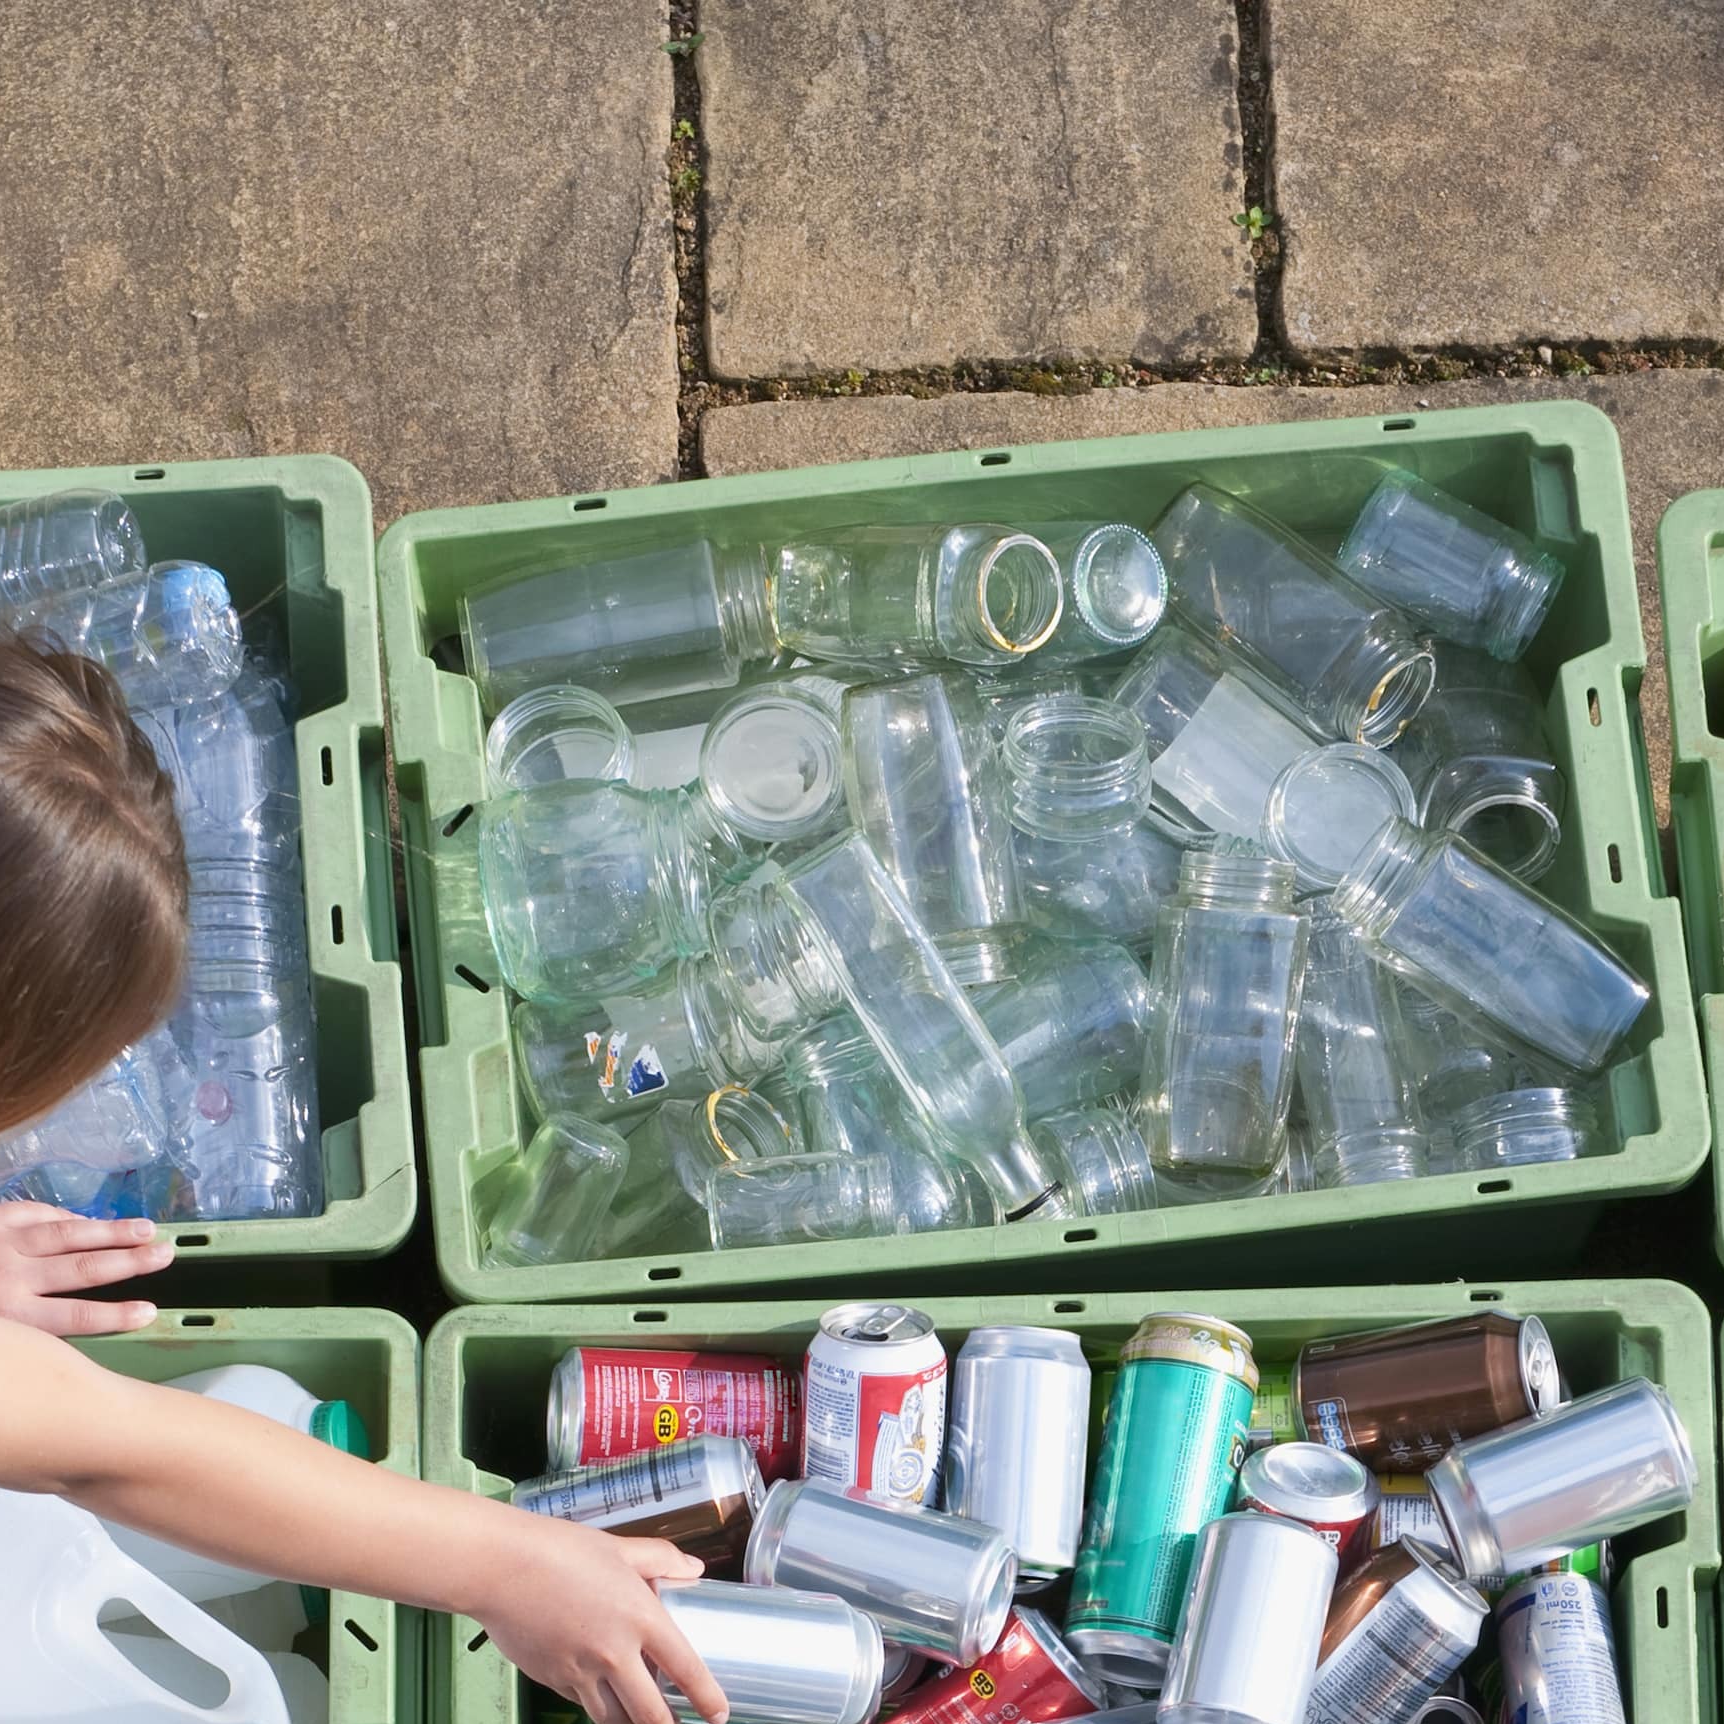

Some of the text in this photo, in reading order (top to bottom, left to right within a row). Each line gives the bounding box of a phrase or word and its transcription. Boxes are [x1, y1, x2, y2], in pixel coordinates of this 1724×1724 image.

[659, 1409, 672, 1437] GB
[560, 1493, 571, 1510] 330
[975, 1670, 994, 1693] GB
